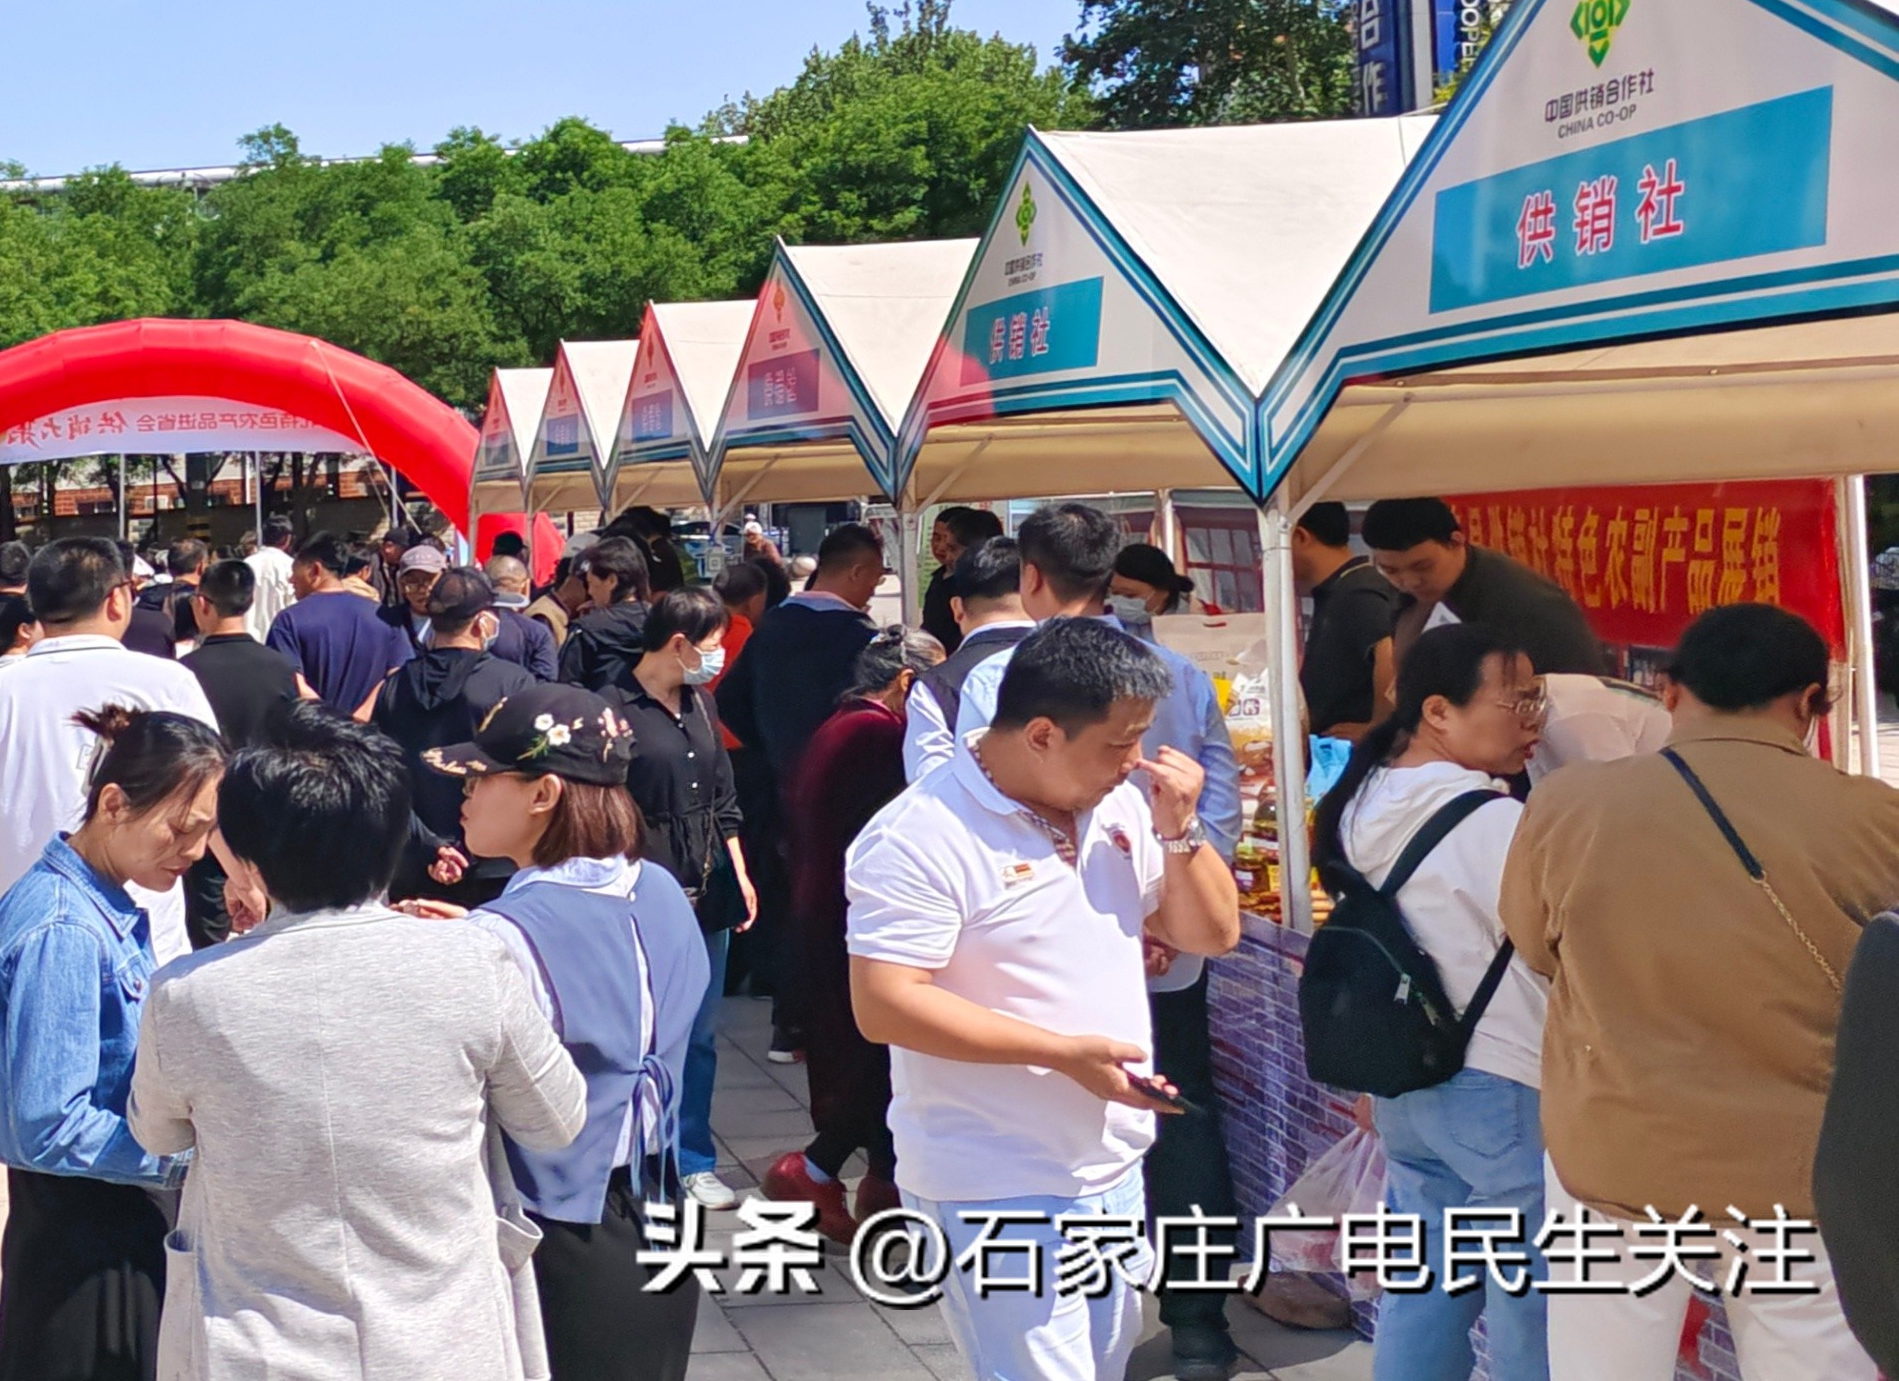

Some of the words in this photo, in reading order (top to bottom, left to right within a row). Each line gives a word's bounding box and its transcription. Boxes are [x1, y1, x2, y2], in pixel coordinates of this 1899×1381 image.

[1544, 69, 1655, 123] 中国供销合作社
[1557, 119, 1595, 139] CHINA
[1597, 103, 1638, 128] CO-OP
[1516, 158, 1685, 269] 供销社
[989, 306, 1050, 365] 供销社
